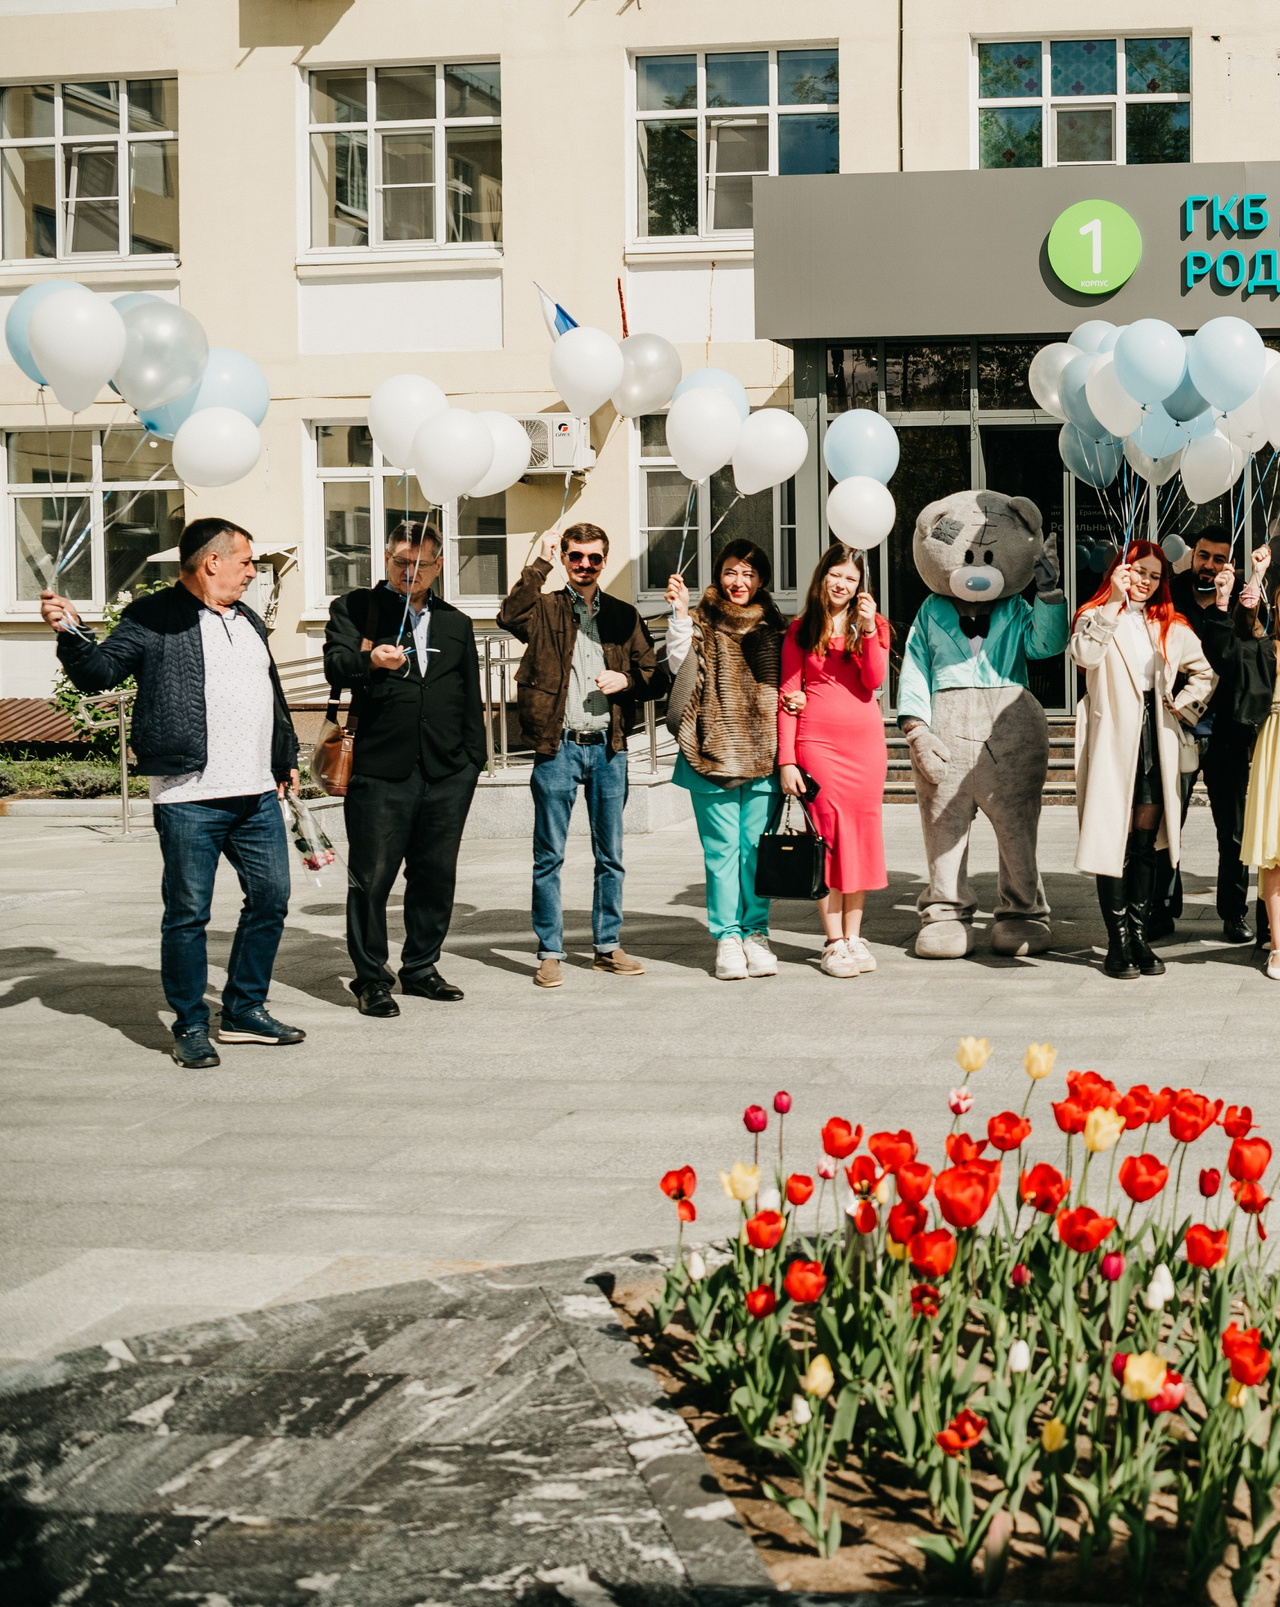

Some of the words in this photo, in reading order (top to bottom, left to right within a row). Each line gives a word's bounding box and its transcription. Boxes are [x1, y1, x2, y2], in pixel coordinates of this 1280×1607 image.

[1185, 193, 1269, 232] ГКБ
[1079, 218, 1102, 274] 1
[1080, 280, 1109, 288] КОРПУС
